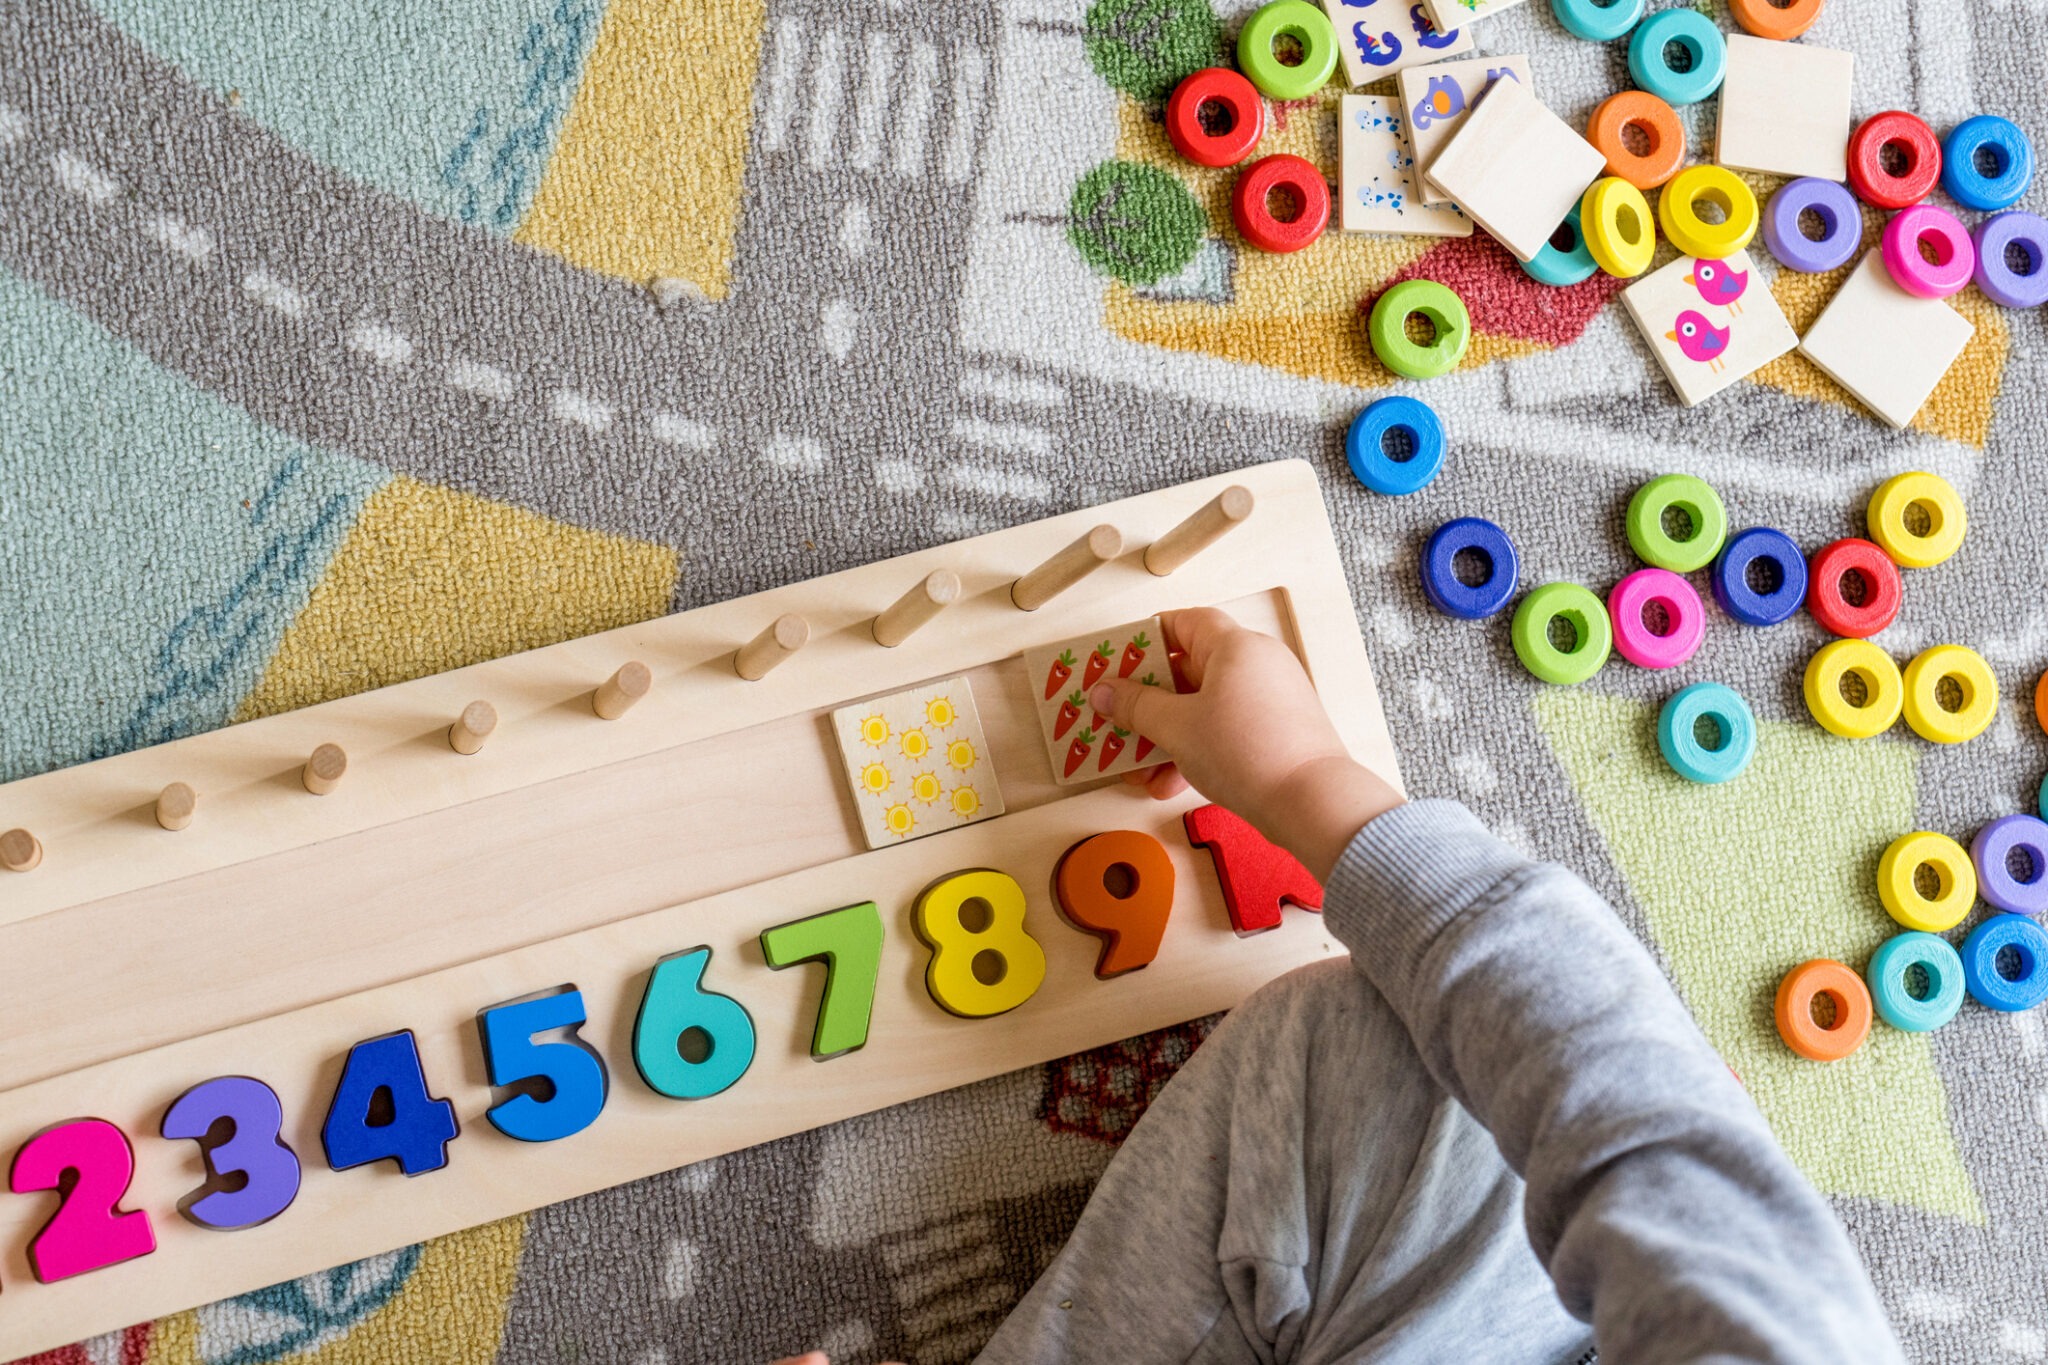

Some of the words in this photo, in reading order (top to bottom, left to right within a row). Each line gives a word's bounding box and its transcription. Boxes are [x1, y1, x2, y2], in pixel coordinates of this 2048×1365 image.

[11, 1117, 156, 1284] 2
[161, 1076, 301, 1231] 3
[321, 1029, 459, 1176] 4
[479, 984, 609, 1142] 5
[632, 945, 756, 1100] 6
[761, 901, 884, 1061] 7
[912, 868, 1046, 1018] 8
[1052, 830, 1175, 979] 9
